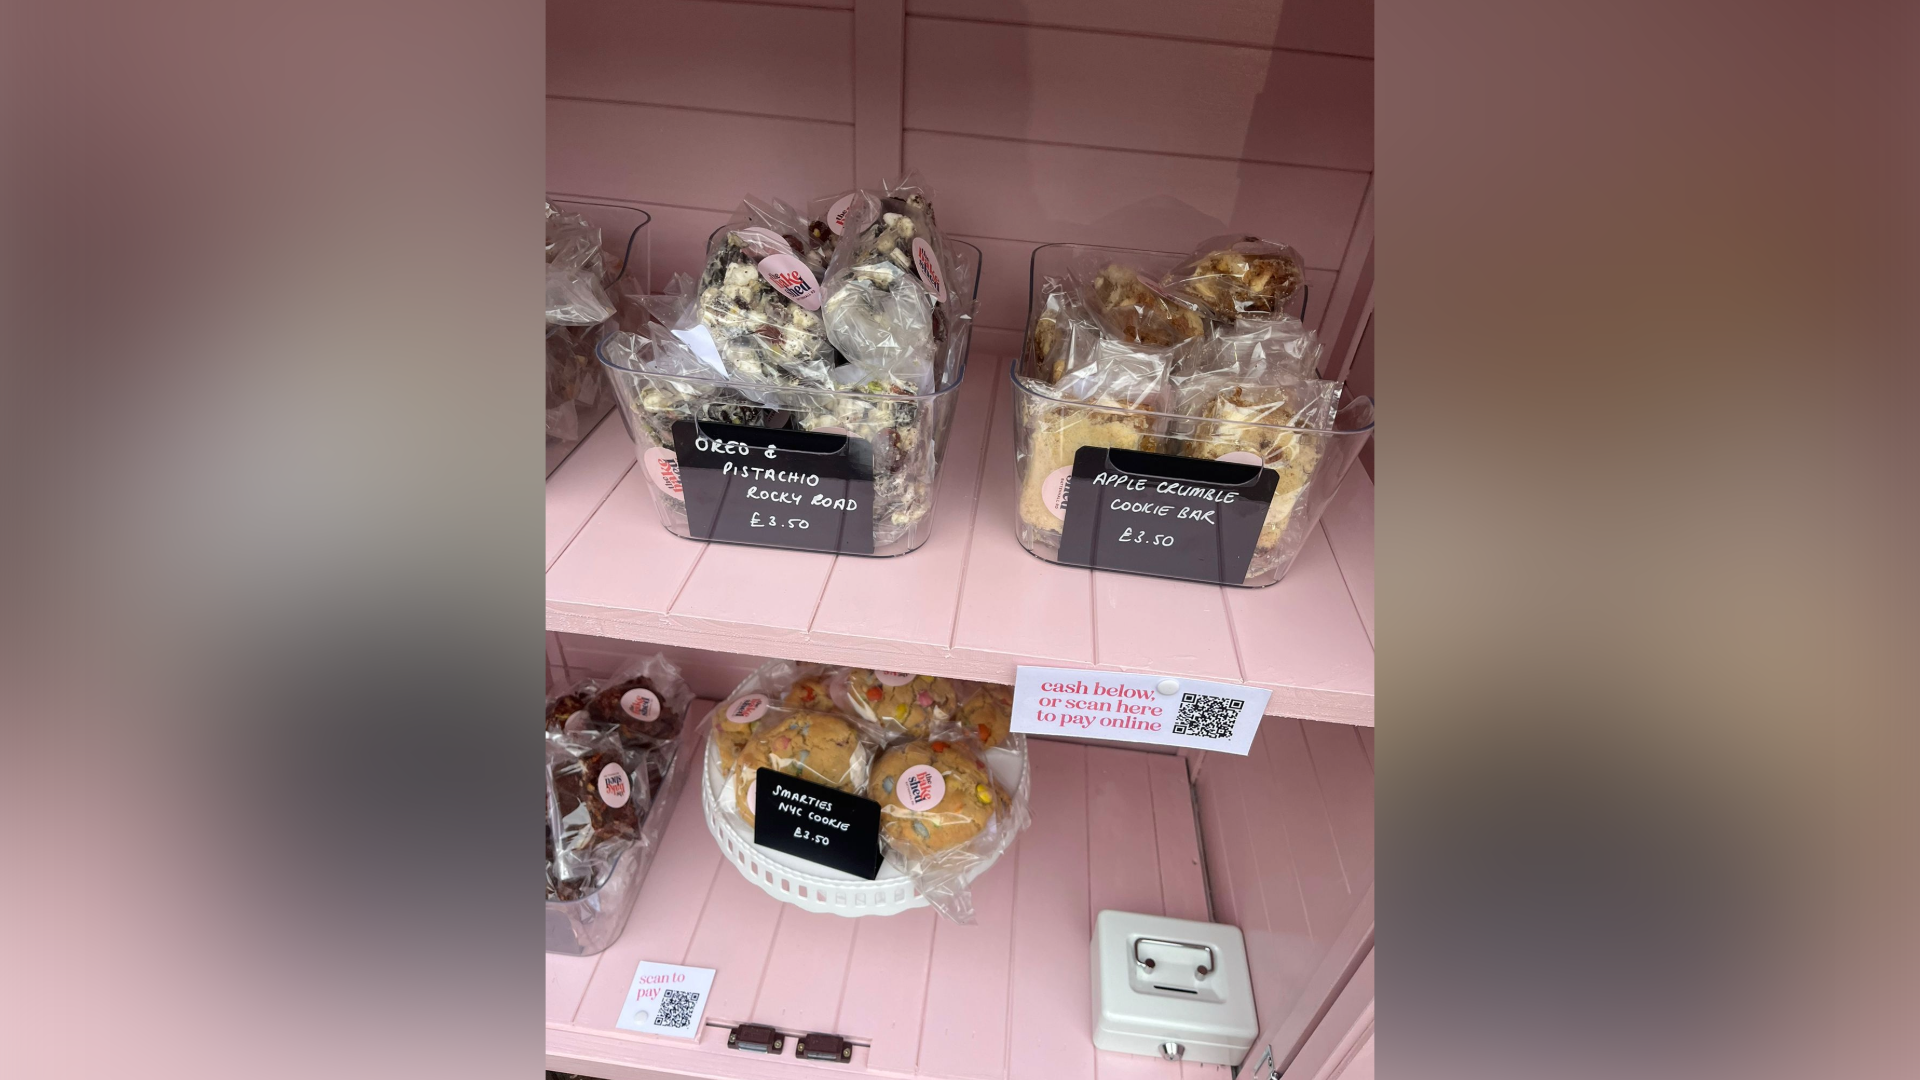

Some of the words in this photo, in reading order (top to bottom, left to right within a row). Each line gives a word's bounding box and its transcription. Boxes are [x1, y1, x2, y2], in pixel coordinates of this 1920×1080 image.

[769, 270, 803, 289] bake
[784, 276, 811, 298] shed
[695, 437, 750, 456] OREO
[723, 461, 820, 487] PISTACHIO
[746, 486, 802, 506] ROCKY
[811, 494, 858, 511] ROAD
[1093, 472, 1148, 491] APPLE
[1156, 482, 1240, 504] CRUMBLE
[750, 512, 810, 530] £3.50
[1110, 499, 1175, 517] COOKIE
[1177, 506, 1216, 525] BAR
[1118, 527, 1175, 547] £3.50
[1041, 680, 1088, 695] cash
[1093, 682, 1156, 702] below,
[1038, 697, 1062, 708] or
[1064, 698, 1112, 712] scan
[1116, 700, 1163, 717] here
[1036, 709, 1057, 722] to
[1059, 713, 1097, 729] pay
[1099, 716, 1162, 732] online
[908, 776, 927, 803] shed
[916, 771, 932, 800] bake
[772, 784, 833, 812] SMARTIES
[778, 802, 802, 816] NYC
[808, 812, 850, 831] COOKIE
[793, 827, 830, 846] £3.50
[639, 974, 670, 984] scan
[672, 972, 685, 983] to
[636, 988, 661, 1001] pay
